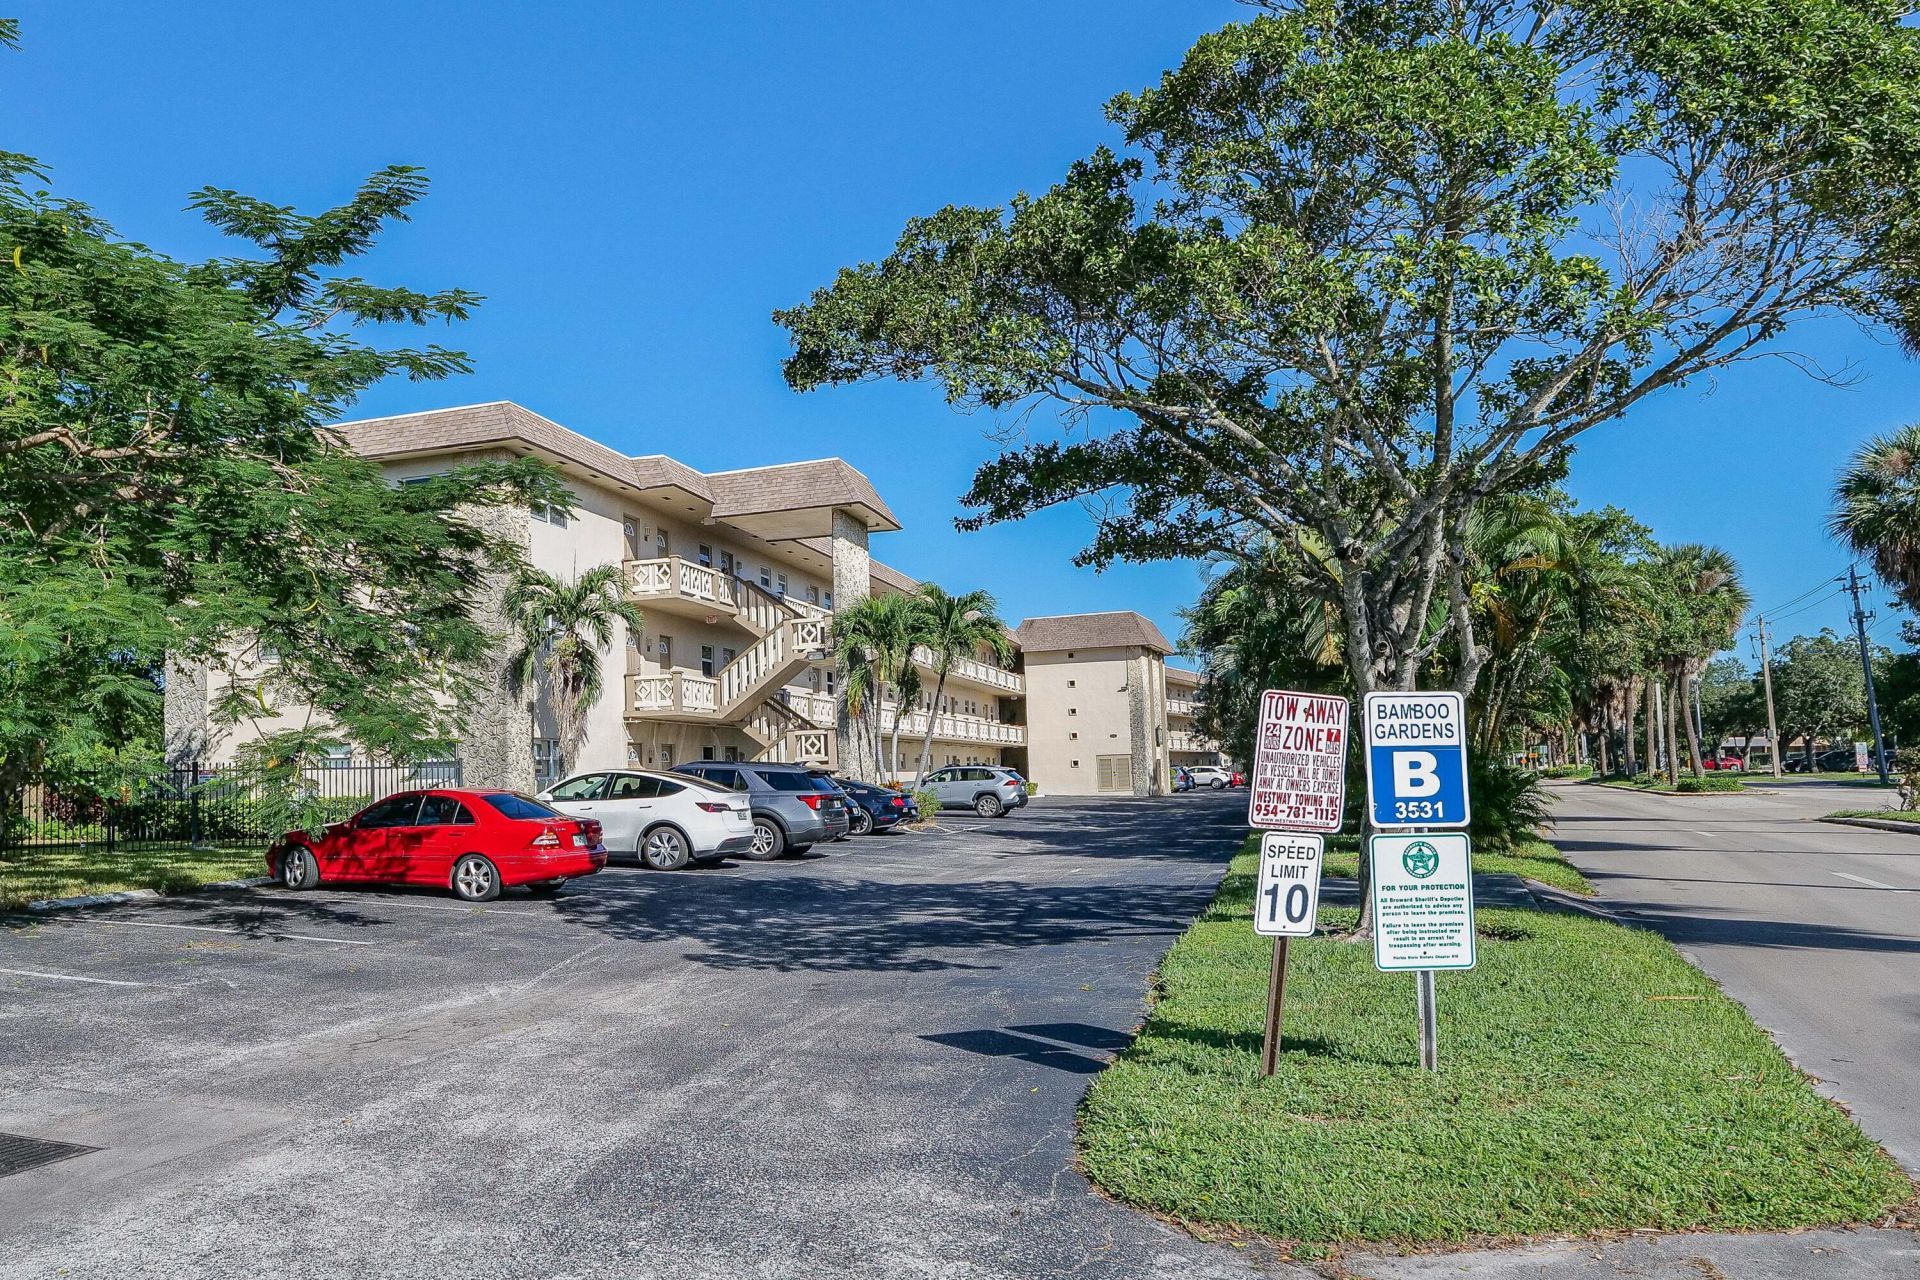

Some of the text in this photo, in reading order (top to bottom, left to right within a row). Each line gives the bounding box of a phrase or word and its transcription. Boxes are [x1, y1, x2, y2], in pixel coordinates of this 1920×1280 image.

[1268, 696, 1343, 725] TOW AWAY
[1378, 704, 1449, 719] BAMBOO
[1266, 724, 1280, 736] 24
[1331, 730, 1337, 741] 7
[1375, 723, 1454, 739] GARDENS
[1282, 726, 1324, 752] ZONE
[1326, 742, 1340, 754] DAYS
[1261, 751, 1340, 768] UNAUTHORIZED VEHICLES
[1260, 764, 1339, 781] OR VESSELS WILL BE TOWED
[1393, 751, 1440, 797] B
[1258, 777, 1339, 794] AWAY AT OWNERS EXPENSE
[1257, 791, 1339, 808] WESTWAY TOWING INC
[1255, 804, 1337, 820] 954-731-1115
[1395, 802, 1443, 818] 3531
[1268, 845, 1315, 860] SPEED
[1271, 864, 1308, 879] LIMIT
[1265, 884, 1308, 923] 10
